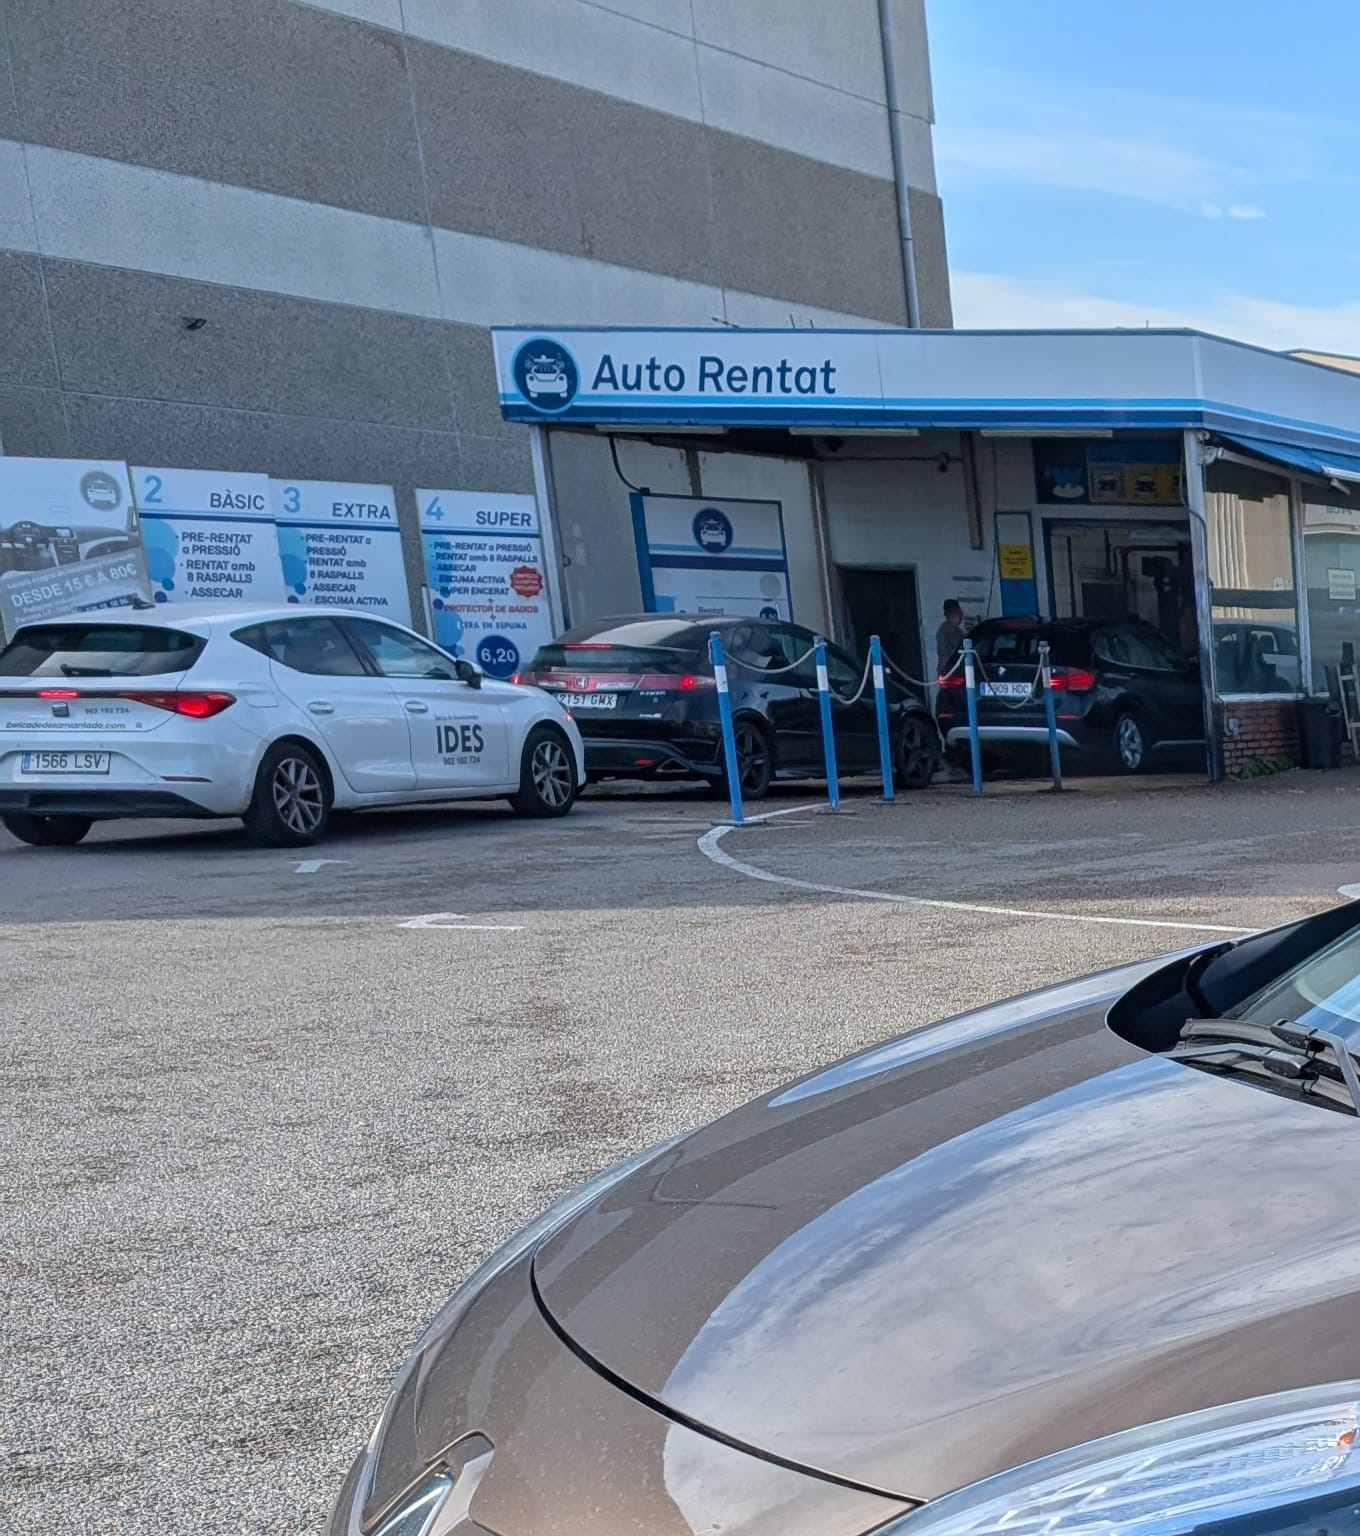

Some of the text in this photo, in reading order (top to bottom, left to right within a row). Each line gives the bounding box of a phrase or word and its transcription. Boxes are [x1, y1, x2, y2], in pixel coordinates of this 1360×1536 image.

[591, 354, 837, 394] Auto Rentat
[144, 475, 163, 503] 2
[209, 489, 265, 510] BÀSIC
[283, 487, 301, 513] 3
[332, 502, 391, 519] EXTRA
[425, 496, 444, 520] 4
[475, 510, 532, 527] SUPER
[181, 531, 253, 544] PRE-RENTAT
[305, 533, 364, 545] PRE-RENTAT
[192, 543, 241, 556] PRESSIÓ
[306, 545, 346, 556] PRESSIÓ
[434, 541, 488, 552] PRE-RENTAT
[495, 543, 532, 553] PRESSIÓ
[309, 557, 345, 567] RENTAT
[435, 553, 468, 562] RENTAT
[186, 559, 256, 572] RENTAT amb
[196, 572, 253, 583] RASPALLS
[317, 570, 364, 580] RASPALLS
[10, 583, 63, 607] DESDE
[64, 576, 83, 592] 15
[97, 570, 109, 583] A
[109, 563, 137, 580] 80€
[312, 584, 356, 593] ASSECAR
[190, 587, 243, 598] ASSECAR
[314, 595, 388, 606] ESCUMA ACTIVA
[481, 648, 516, 664] 6,20
[590, 694, 614, 706] GMX
[436, 724, 484, 754] IDES
[35, 753, 102, 768] 1566 LSV
